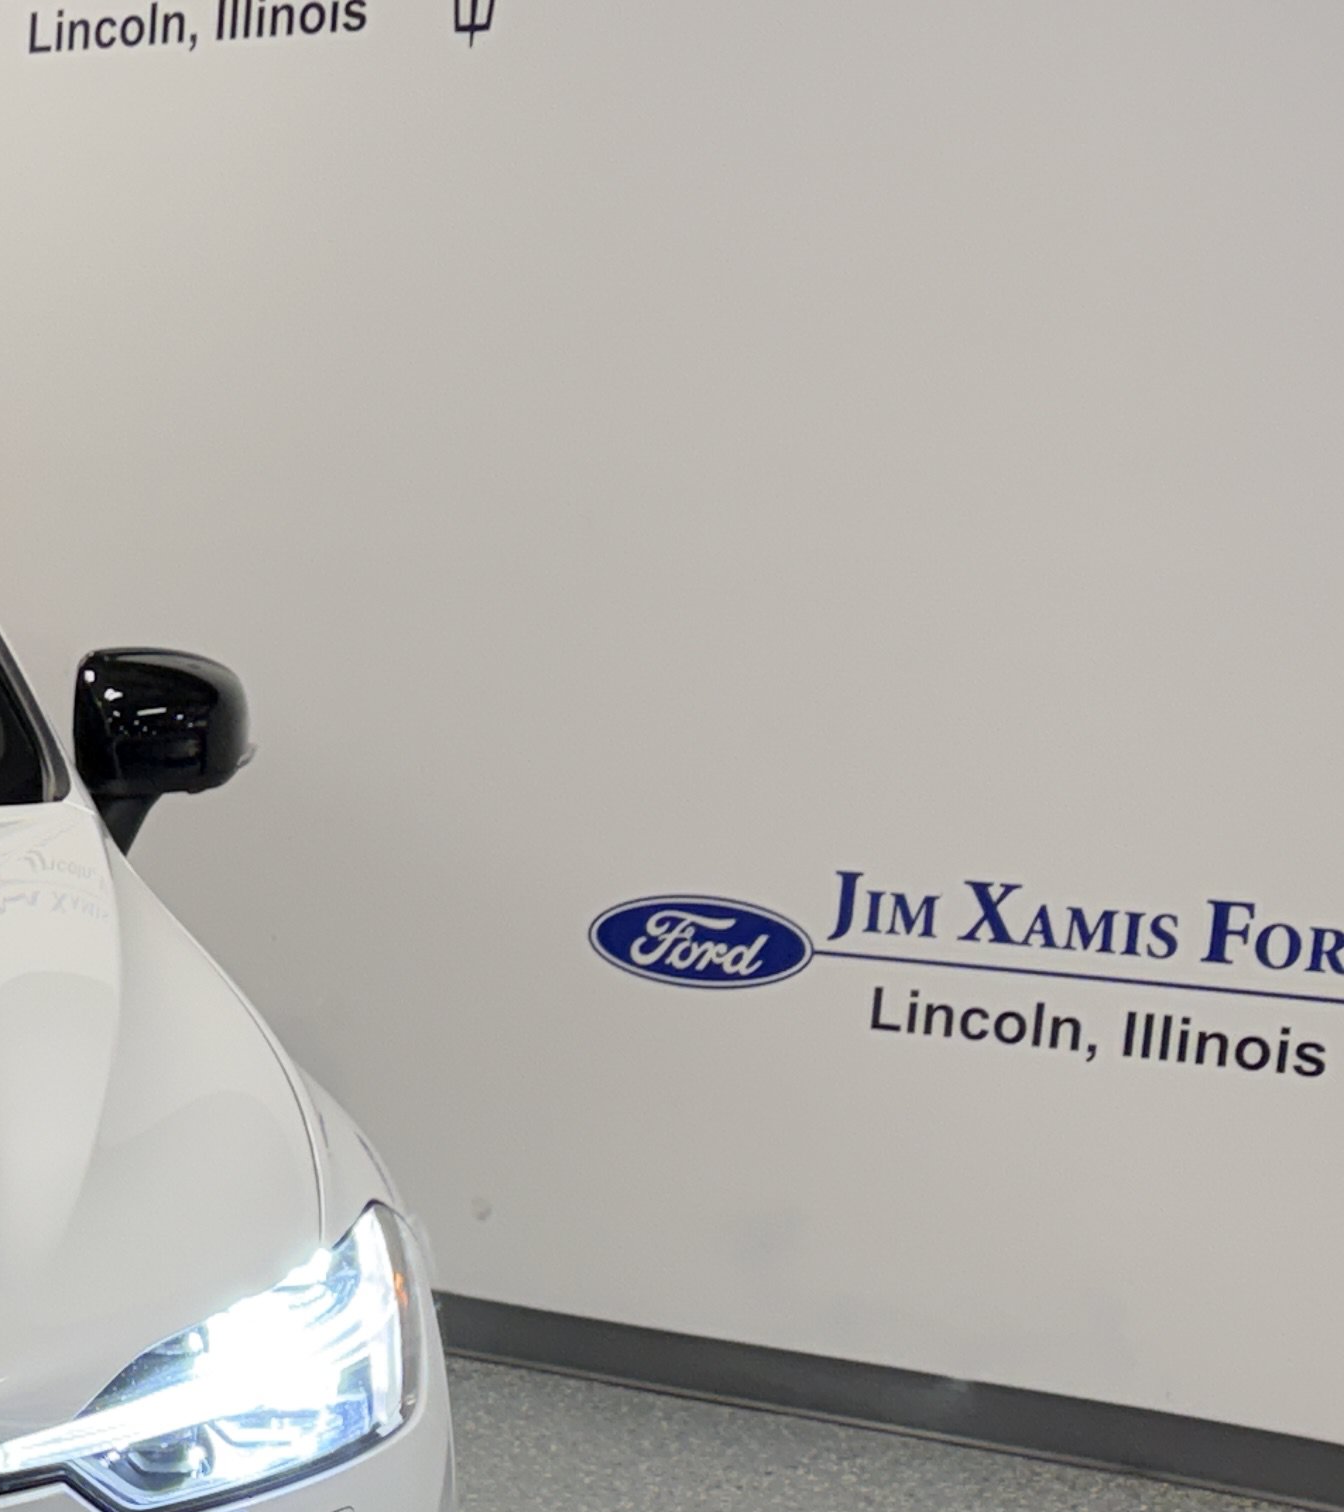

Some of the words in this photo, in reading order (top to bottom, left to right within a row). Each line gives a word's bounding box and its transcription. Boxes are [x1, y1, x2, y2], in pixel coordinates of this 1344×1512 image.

[28, 1, 198, 54] Lincoln,
[630, 907, 769, 977] Ford
[826, 870, 941, 941] JIM
[956, 879, 1179, 960] XAMIS
[869, 985, 1098, 1063] Lincoln,
[1121, 1011, 1328, 1079] Illinois
